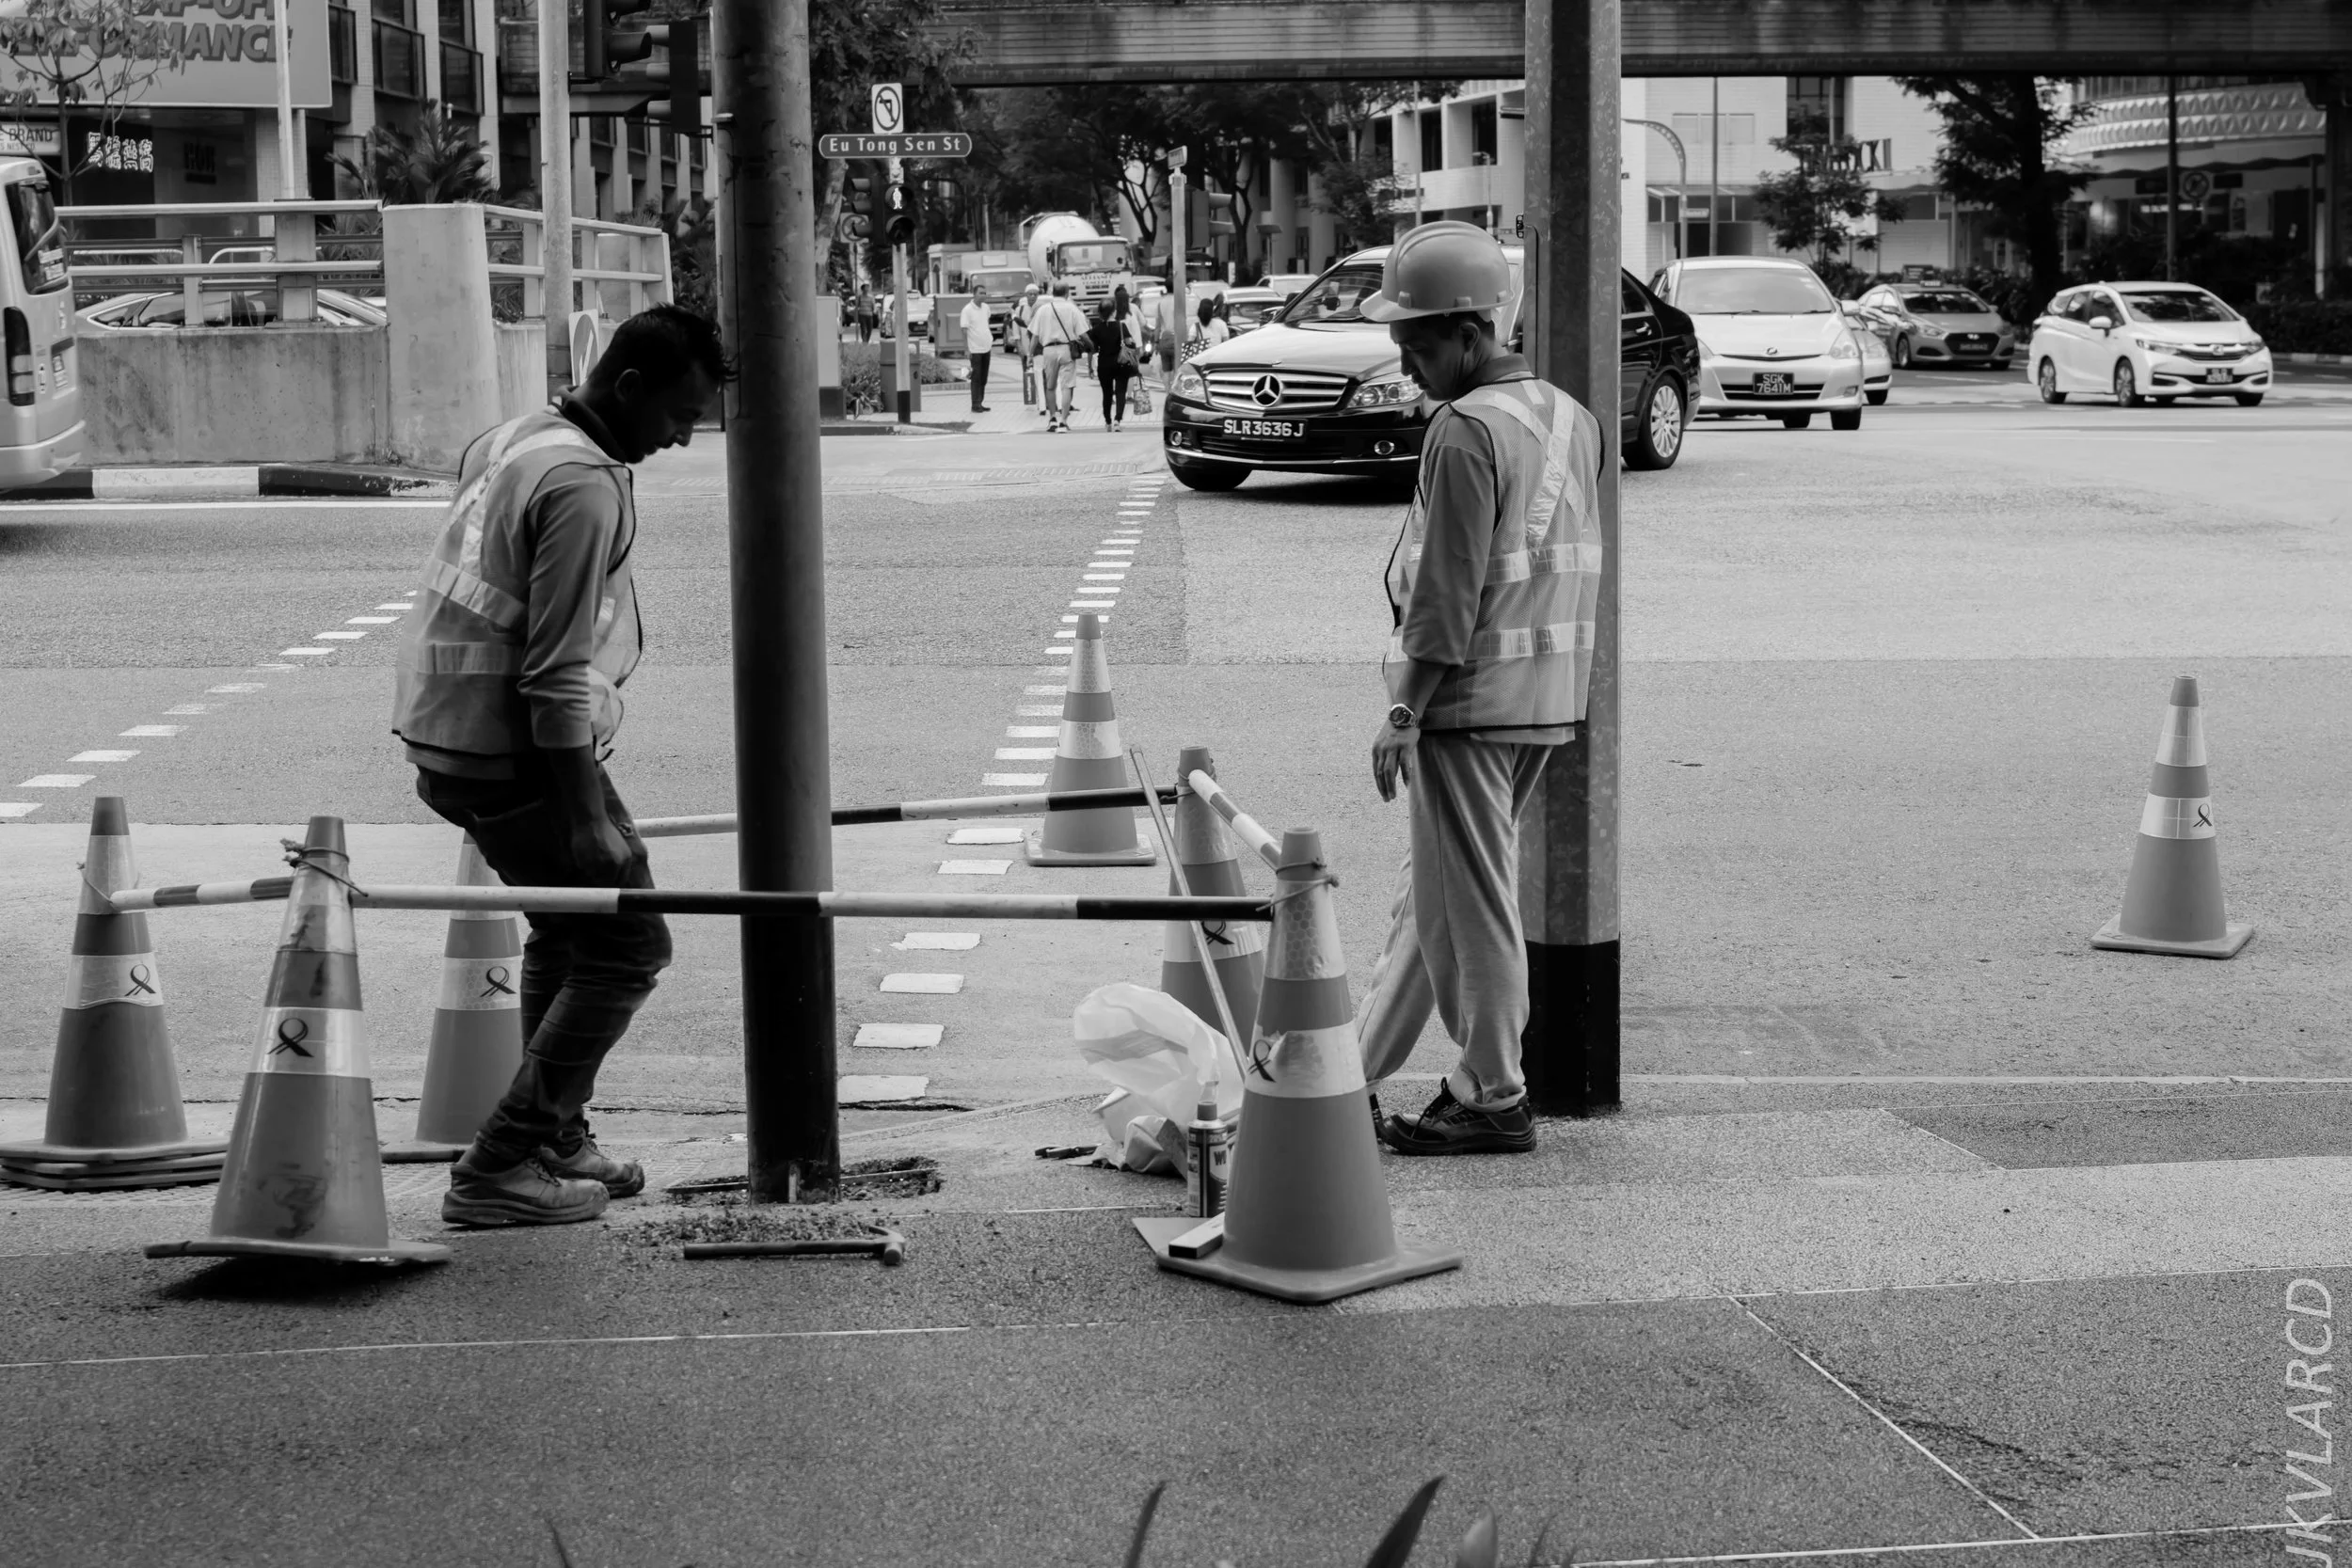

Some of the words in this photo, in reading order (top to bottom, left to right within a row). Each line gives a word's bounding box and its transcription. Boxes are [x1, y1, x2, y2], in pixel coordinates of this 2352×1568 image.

[8, 128, 54, 143] BRAND
[829, 137, 850, 152] Eu
[857, 137, 898, 155] Tong
[904, 136, 936, 151] Sen
[943, 135, 961, 150] St
[1762, 373, 1785, 384] SGK
[1756, 383, 1791, 393] 7641M
[1223, 419, 1305, 437] SLR3636J
